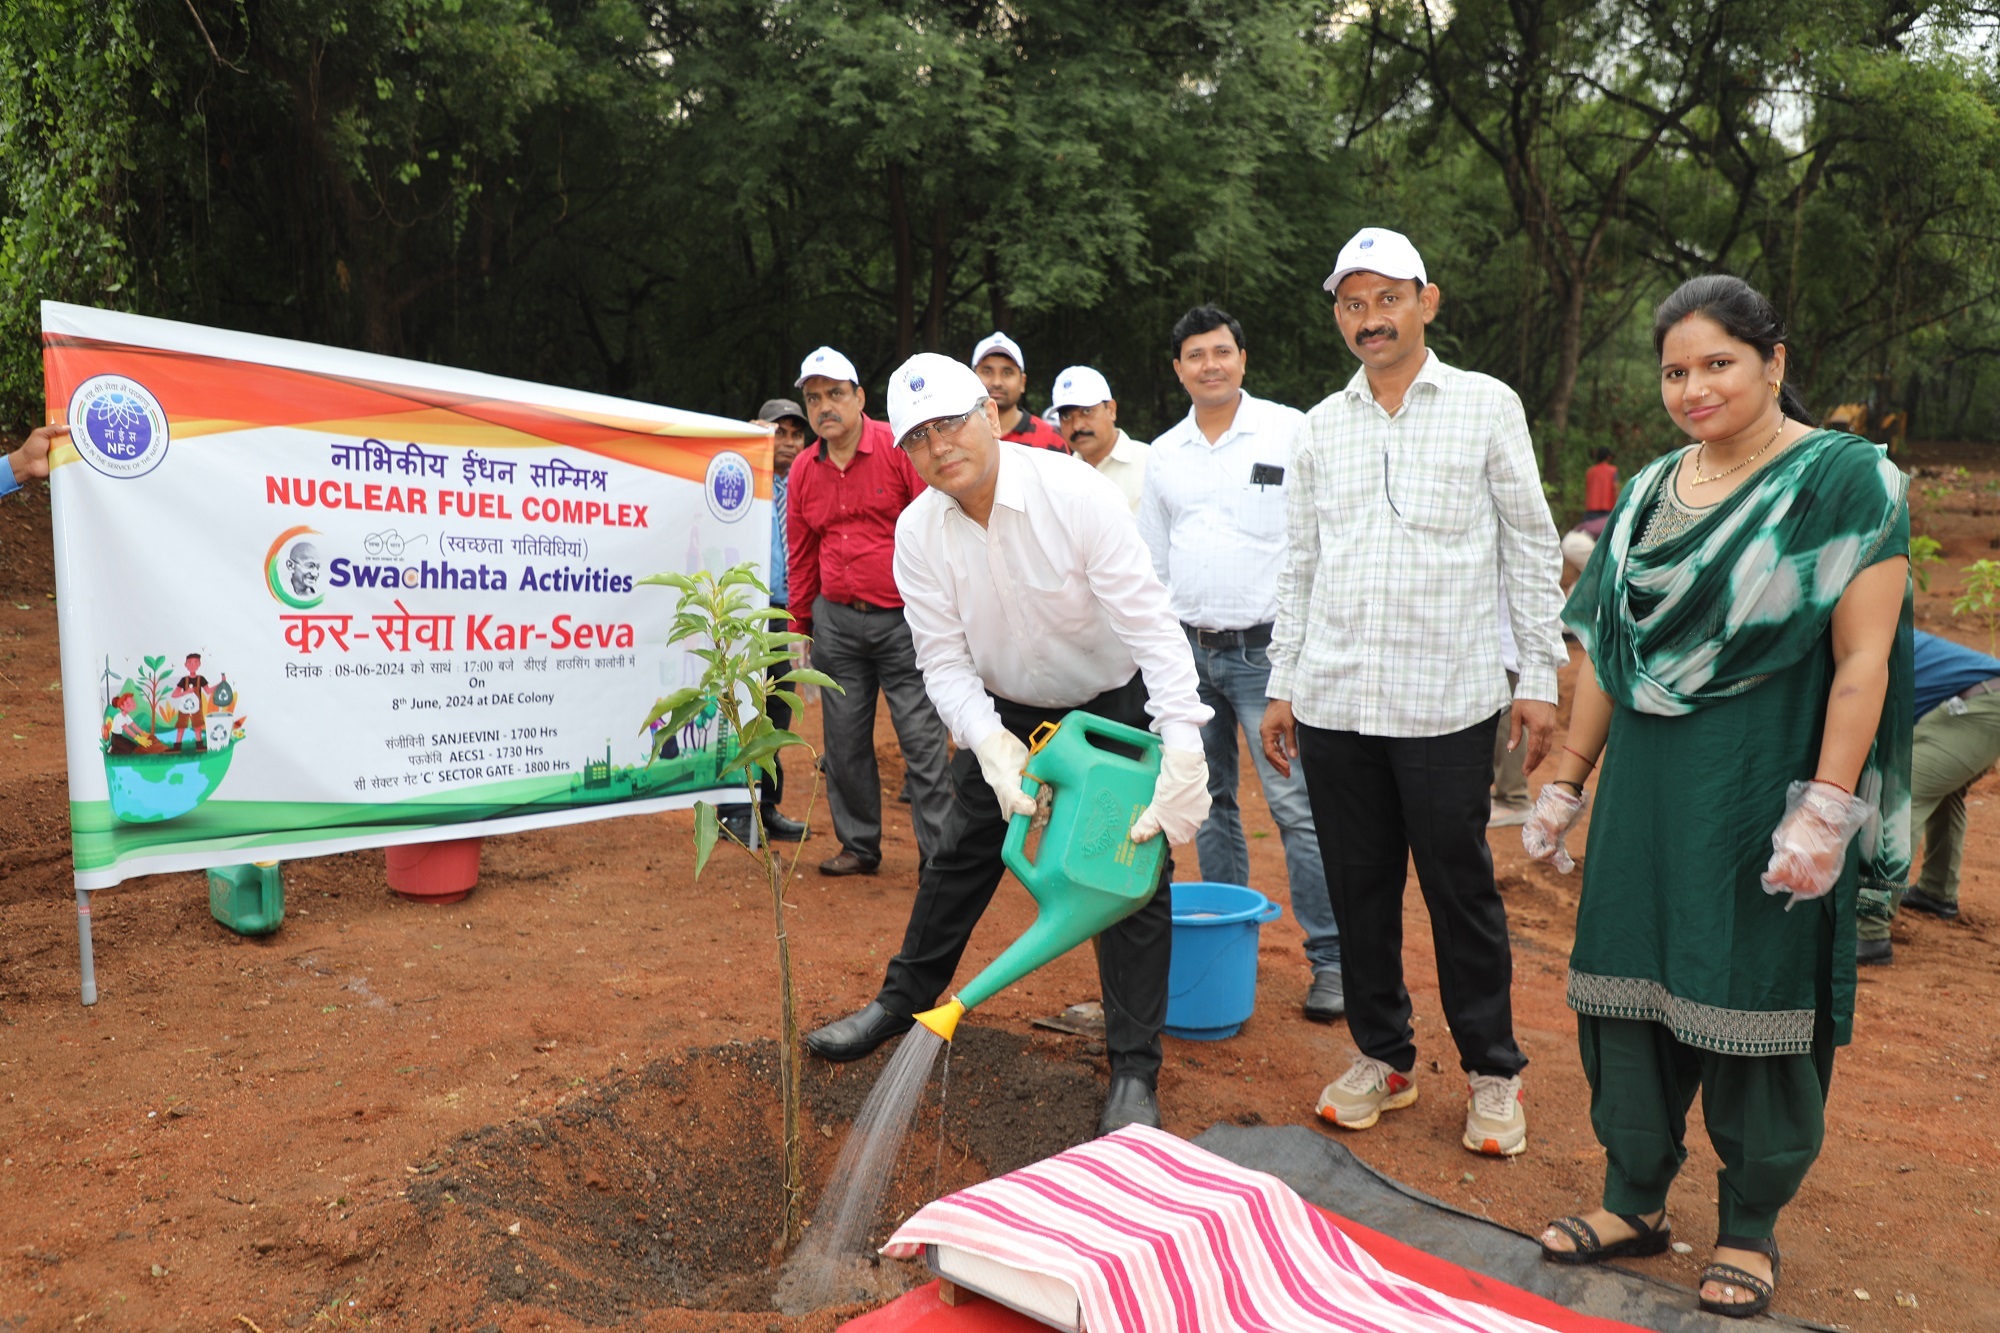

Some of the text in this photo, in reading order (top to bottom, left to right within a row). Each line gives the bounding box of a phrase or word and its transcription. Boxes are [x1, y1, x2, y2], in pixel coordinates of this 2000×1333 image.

[89, 449, 95, 457] IN
[96, 454, 106, 465] THE
[106, 462, 131, 471] SERVICE
[132, 462, 140, 470] OF
[141, 456, 150, 466] THE
[107, 442, 136, 457] NFC
[330, 437, 608, 492] नाभिकीय ईंधन सम्मिश्र
[265, 475, 649, 528] NUCLEAR FUEL COMPLEX
[722, 498, 737, 508] NFC
[439, 530, 589, 562] (स्वच्छता गतिविधियां)
[329, 557, 634, 593] Swachhata Activities
[280, 599, 635, 654] कर-सेवा Kar-Seva
[285, 662, 324, 678] दिनांक
[335, 662, 405, 678] 08-06-2024
[410, 659, 424, 674] को
[463, 660, 493, 673] 17:00
[498, 657, 514, 672] बजे
[523, 656, 548, 672] डीएई
[556, 655, 590, 671] हाउसिंग
[594, 654, 625, 669] कालोनी
[628, 653, 636, 668] में
[468, 676, 486, 689] On
[410, 698, 442, 710] June,
[446, 695, 473, 708] 2024
[477, 695, 488, 706] at
[492, 693, 514, 706] DAE
[518, 692, 554, 706] Colony
[384, 733, 425, 750] संजीविनी
[431, 730, 500, 746] SANJEEVINI
[511, 728, 536, 740] 1700
[540, 727, 558, 738] Hrs
[450, 750, 484, 763] AECS1
[496, 746, 522, 759] 1730
[526, 745, 544, 756] Hrs
[354, 776, 366, 791] सी
[370, 774, 399, 789] सेक्टर
[403, 772, 418, 786] गेट
[438, 768, 483, 783] SECTOR
[486, 764, 514, 778] GATE
[525, 761, 550, 774] 1800
[552, 760, 570, 771] Hrs
